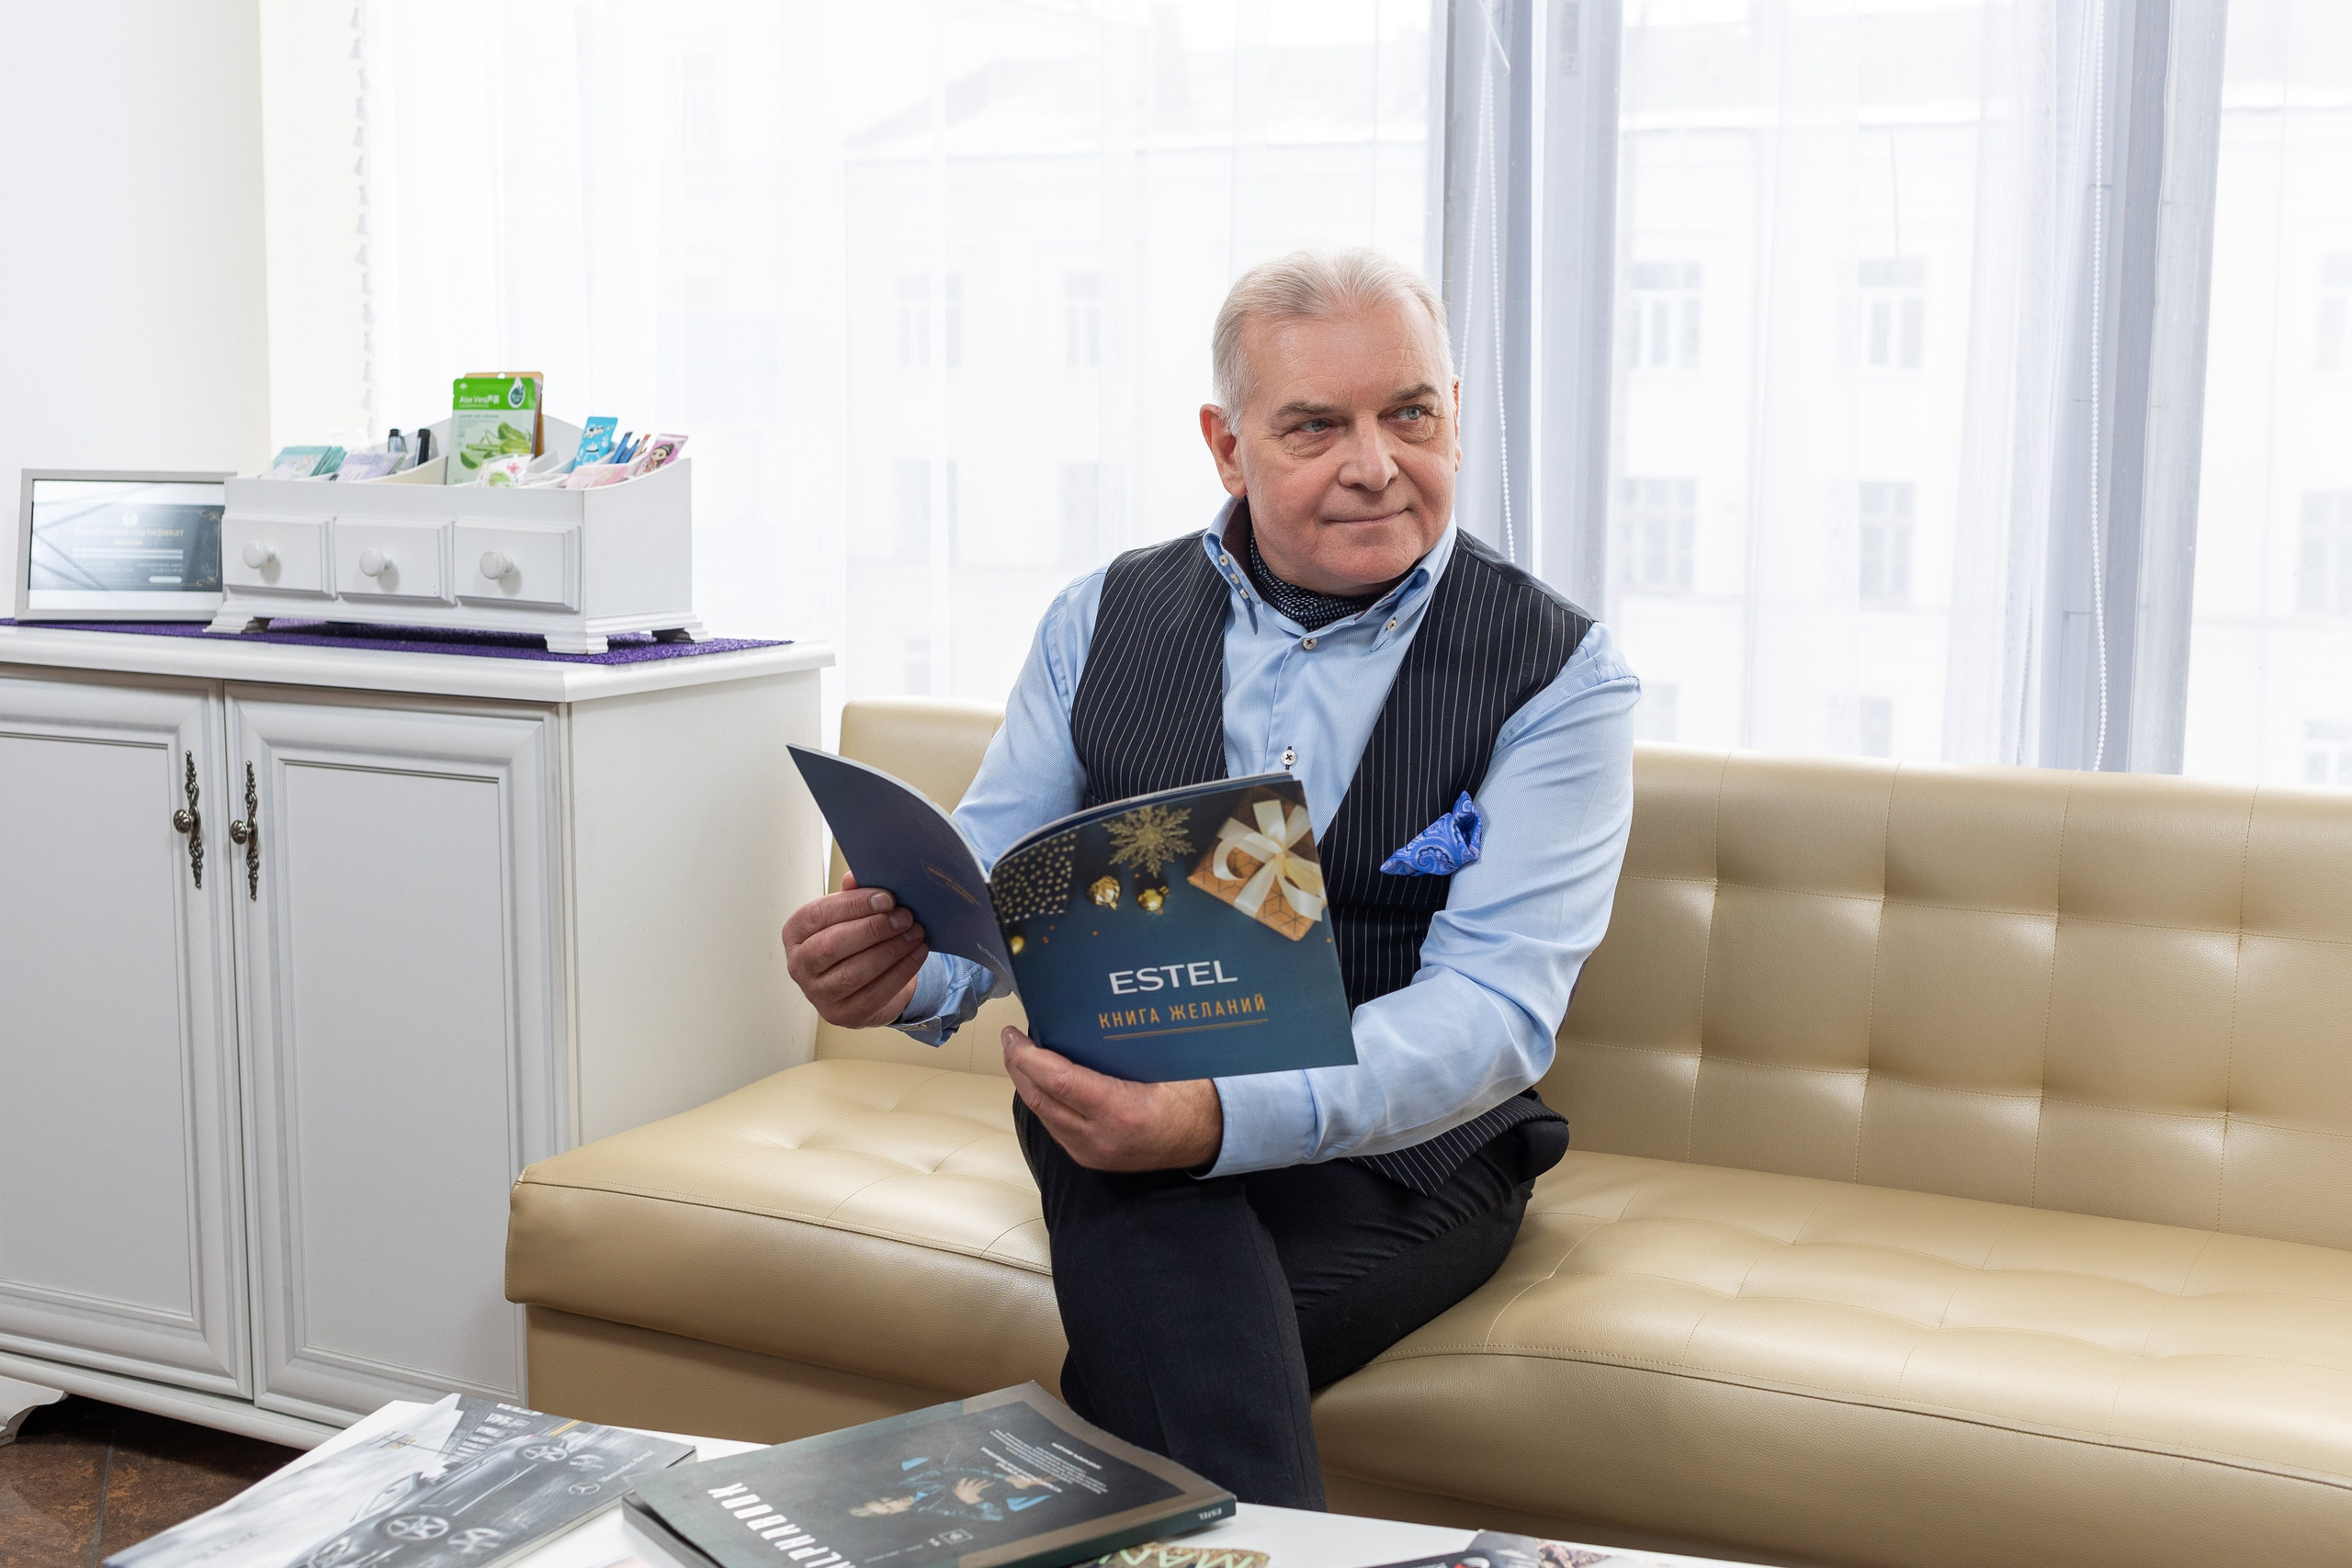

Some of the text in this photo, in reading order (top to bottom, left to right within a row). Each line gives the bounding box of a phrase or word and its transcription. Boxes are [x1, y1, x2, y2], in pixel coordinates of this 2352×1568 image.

[1108, 960, 1238, 996] ESTEL
[1098, 993, 1267, 1030] КНИГА ЖЕЛАНИЙ
[1197, 1506, 1223, 1521] ESTEL
